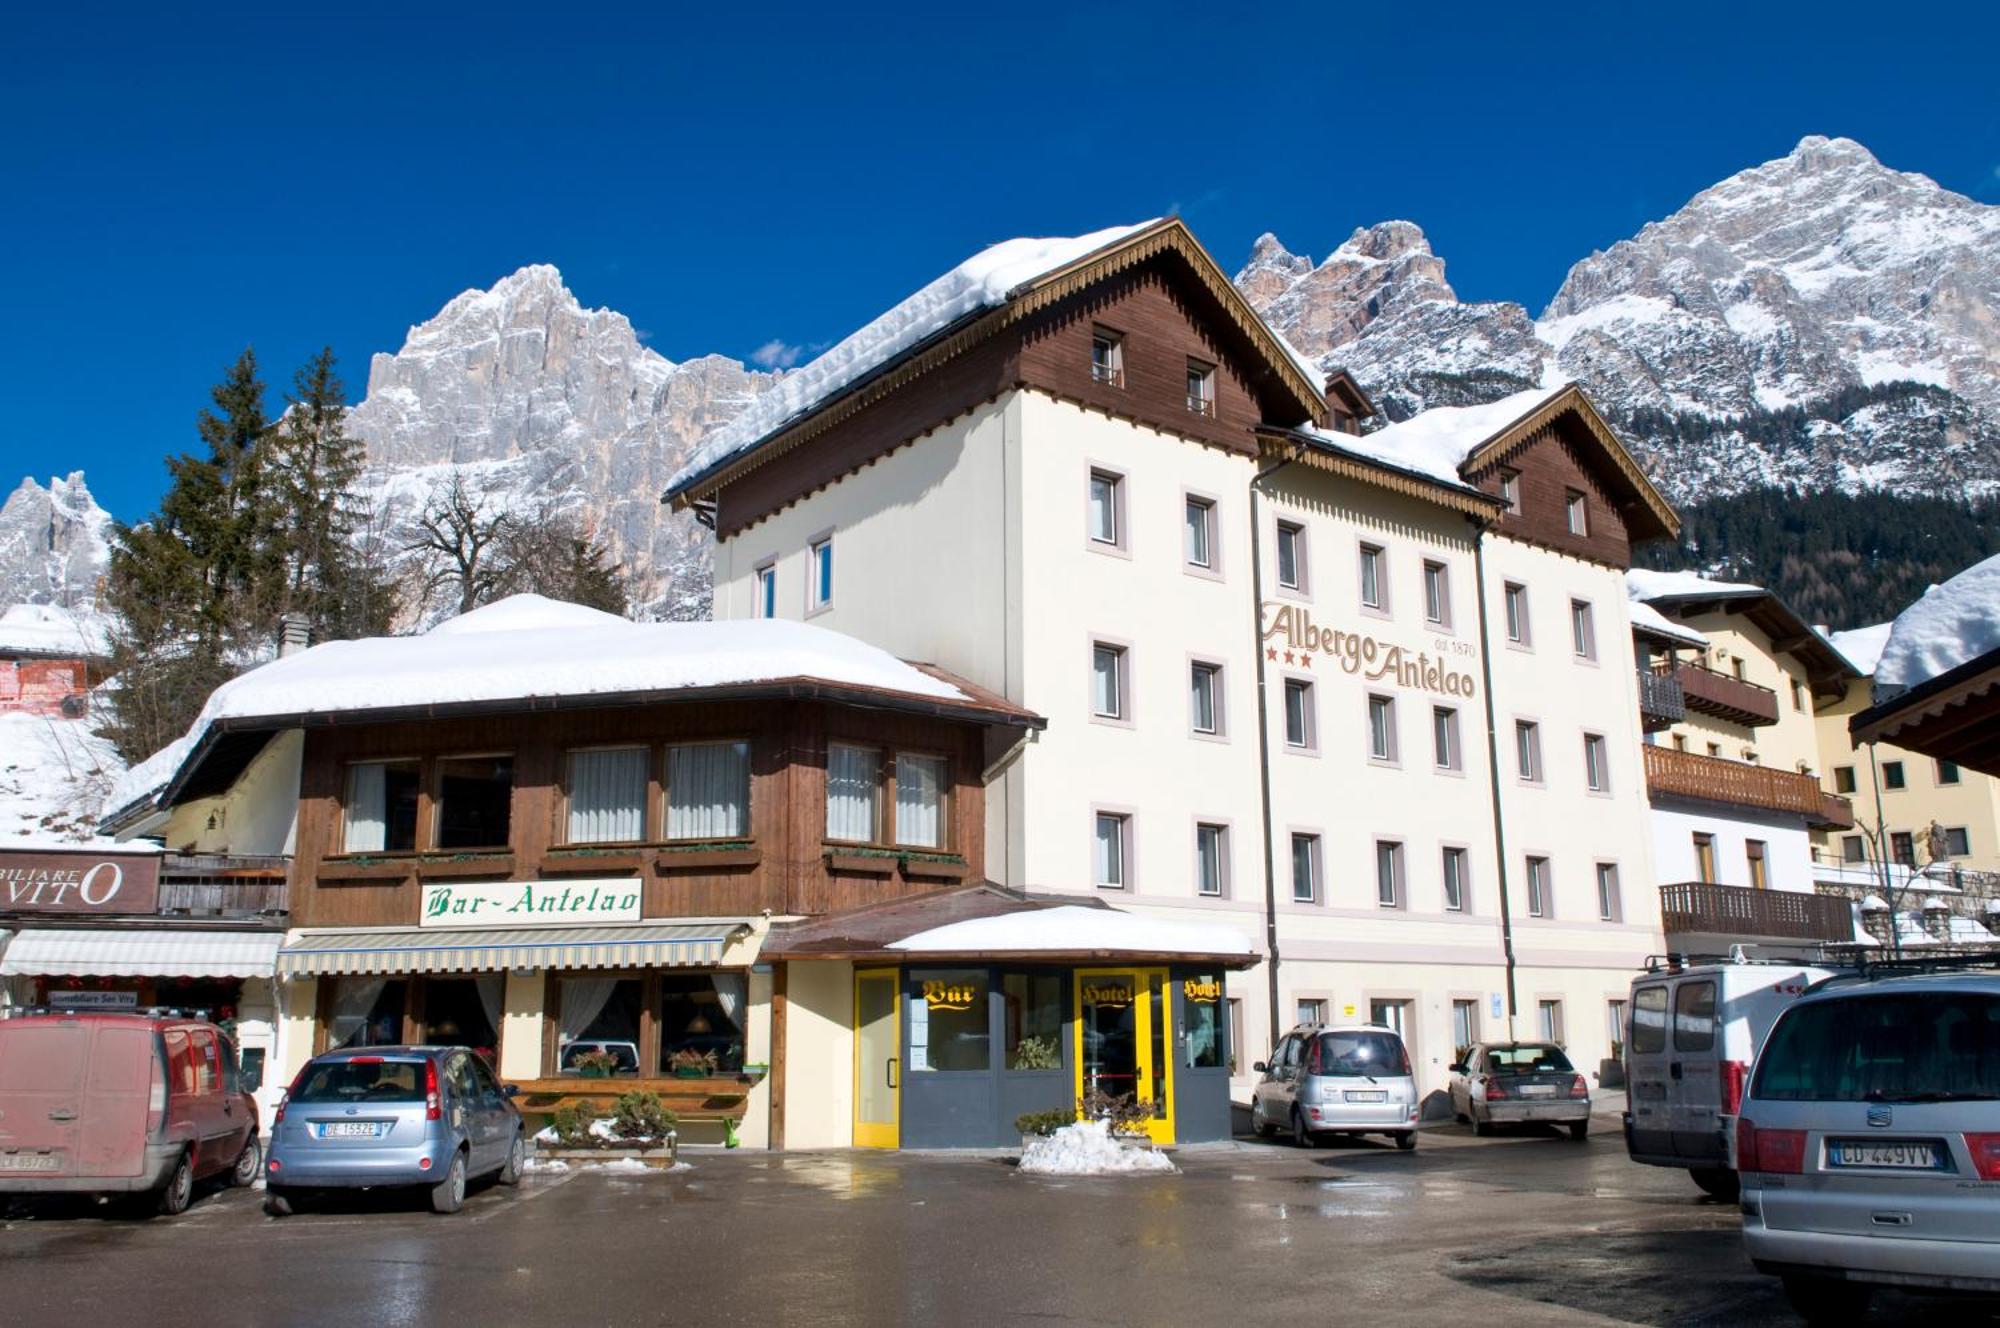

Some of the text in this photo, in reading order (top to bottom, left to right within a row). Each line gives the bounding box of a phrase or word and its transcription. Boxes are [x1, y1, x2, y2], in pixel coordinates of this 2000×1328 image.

[1262, 601, 1378, 674] Albergo
[1452, 641, 1476, 658] 1870
[1365, 642, 1475, 699] Antelao
[9, 862, 123, 905] VITO
[923, 980, 975, 1004] Bar
[1083, 984, 1134, 1003] Hotel
[1184, 979, 1221, 1001] Hotel
[1842, 1143, 1930, 1165] CD 449VV
